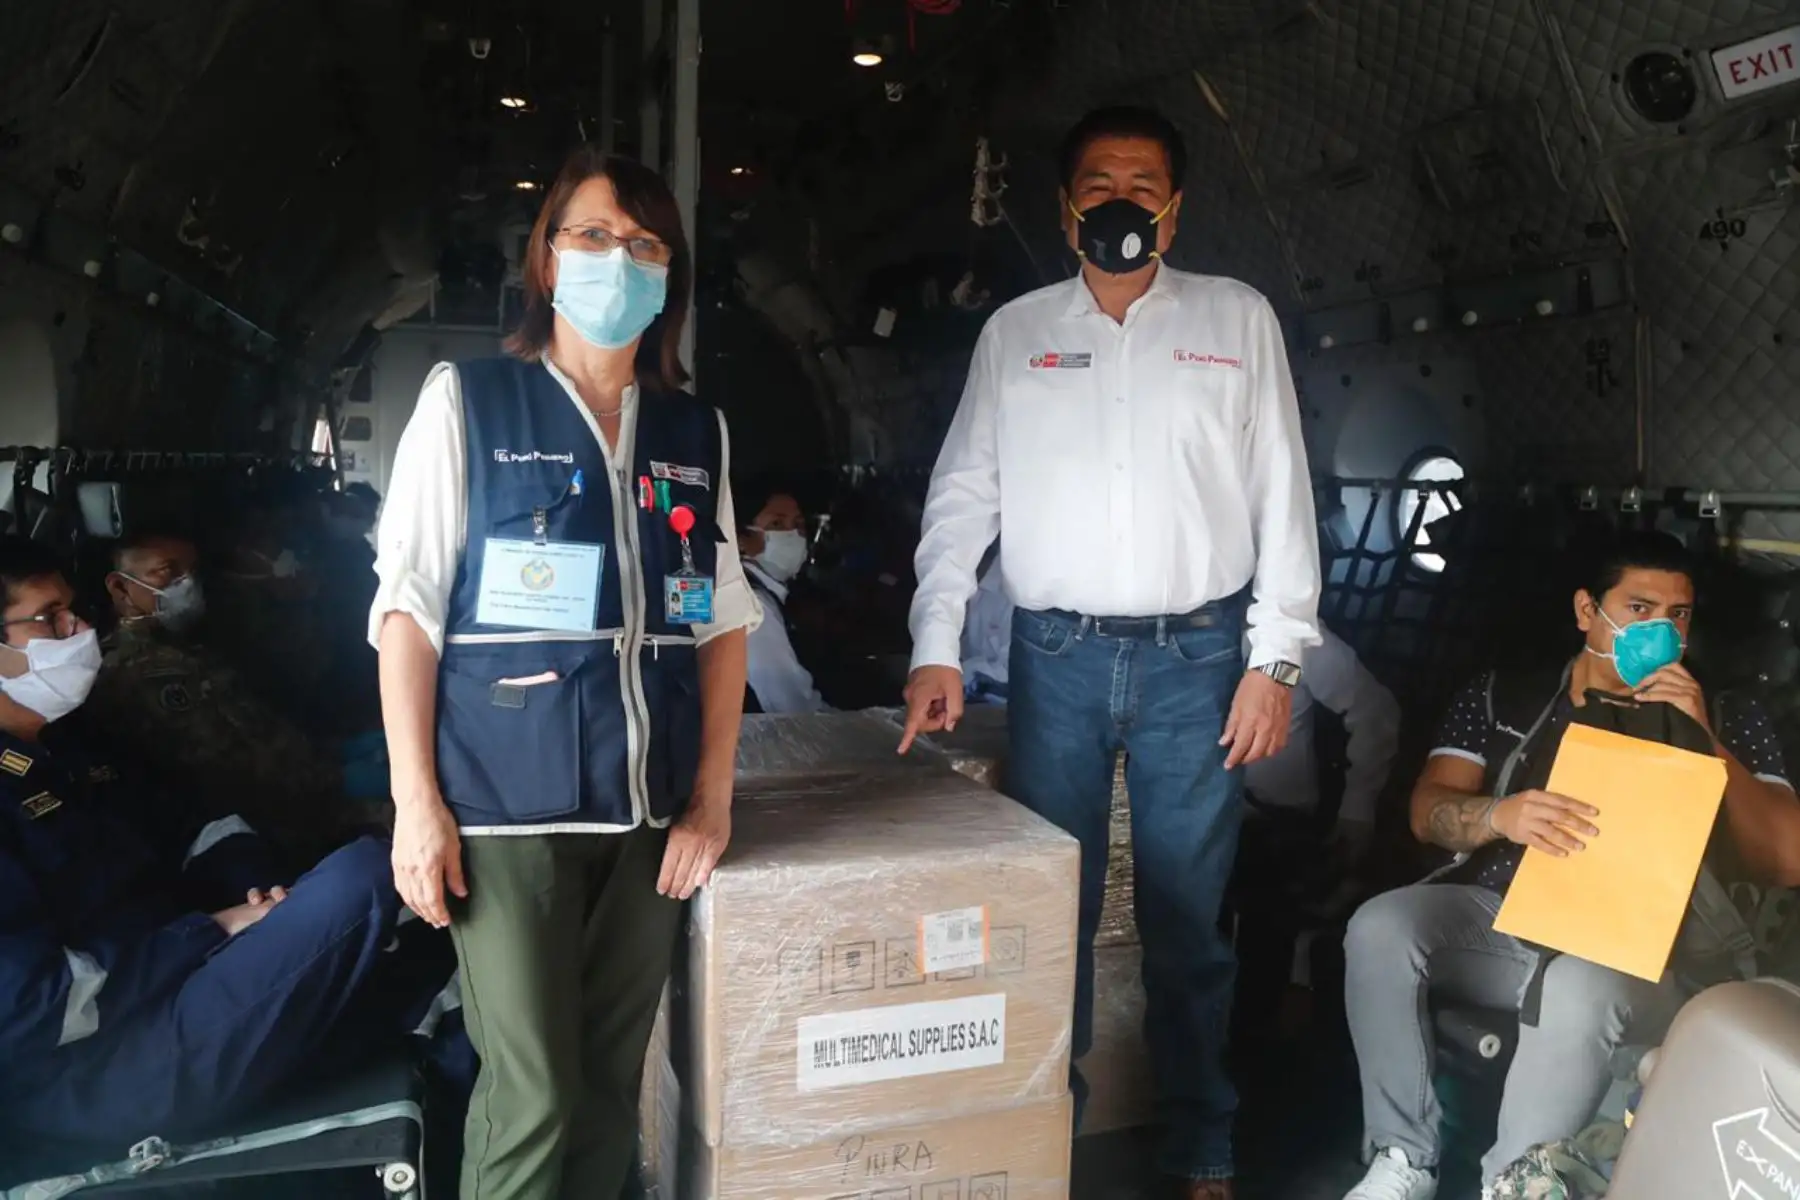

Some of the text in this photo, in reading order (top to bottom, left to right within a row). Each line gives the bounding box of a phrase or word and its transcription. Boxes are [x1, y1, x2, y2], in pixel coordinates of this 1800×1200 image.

[1729, 43, 1793, 85] EXIT
[813, 1017, 999, 1069] MULTIMEDICAL SUPPLIES S.A.C
[1736, 1139, 1800, 1200] EXPAN
